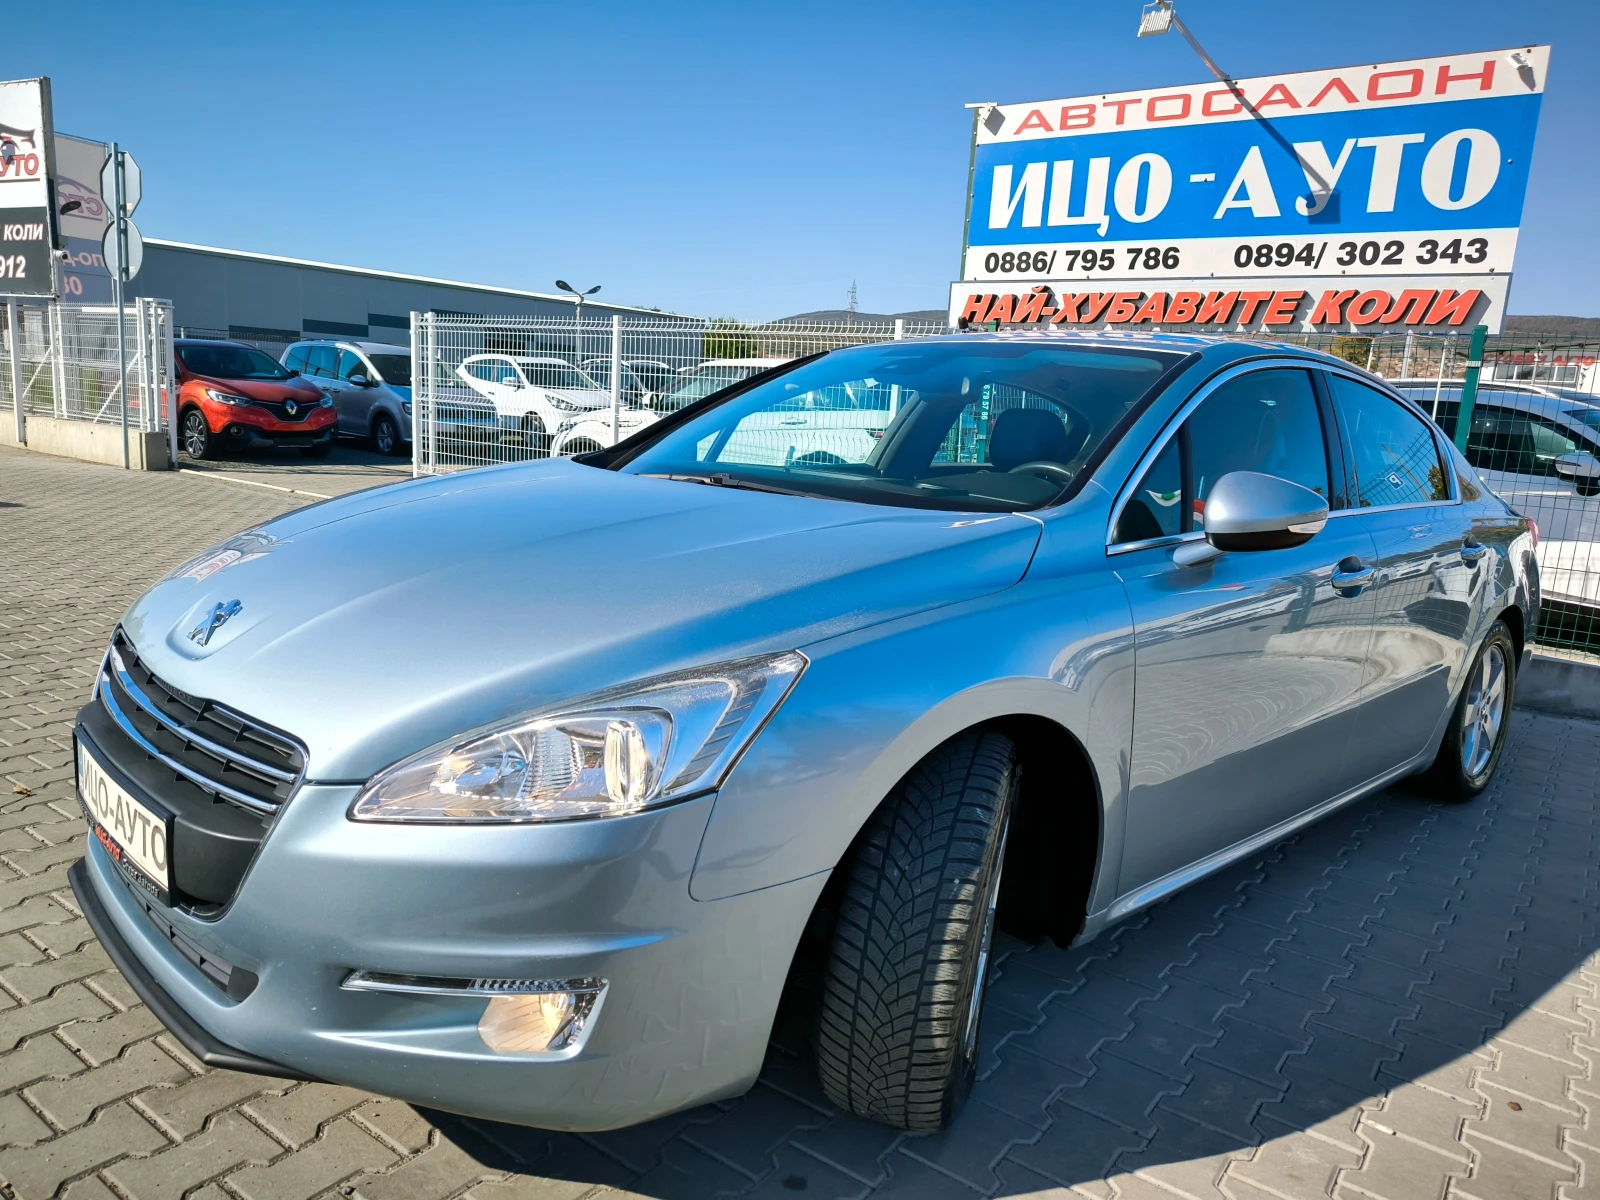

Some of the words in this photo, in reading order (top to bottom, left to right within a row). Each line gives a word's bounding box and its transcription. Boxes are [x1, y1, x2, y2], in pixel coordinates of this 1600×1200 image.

[1014, 60, 1496, 135] АВТОСАЛОН
[3, 223, 44, 242] КОЛИ
[984, 250, 1057, 275] 0886/
[1065, 248, 1116, 272] 795
[1126, 246, 1180, 271] 786
[1234, 241, 1328, 269] 0894/
[1336, 240, 1405, 267] 302
[1416, 237, 1489, 265] 343
[960, 285, 1305, 325] НАЙ-ХУБАВИТЕ
[1309, 289, 1481, 325] КОЛИ
[83, 752, 167, 873] ИЦО-АУТО
